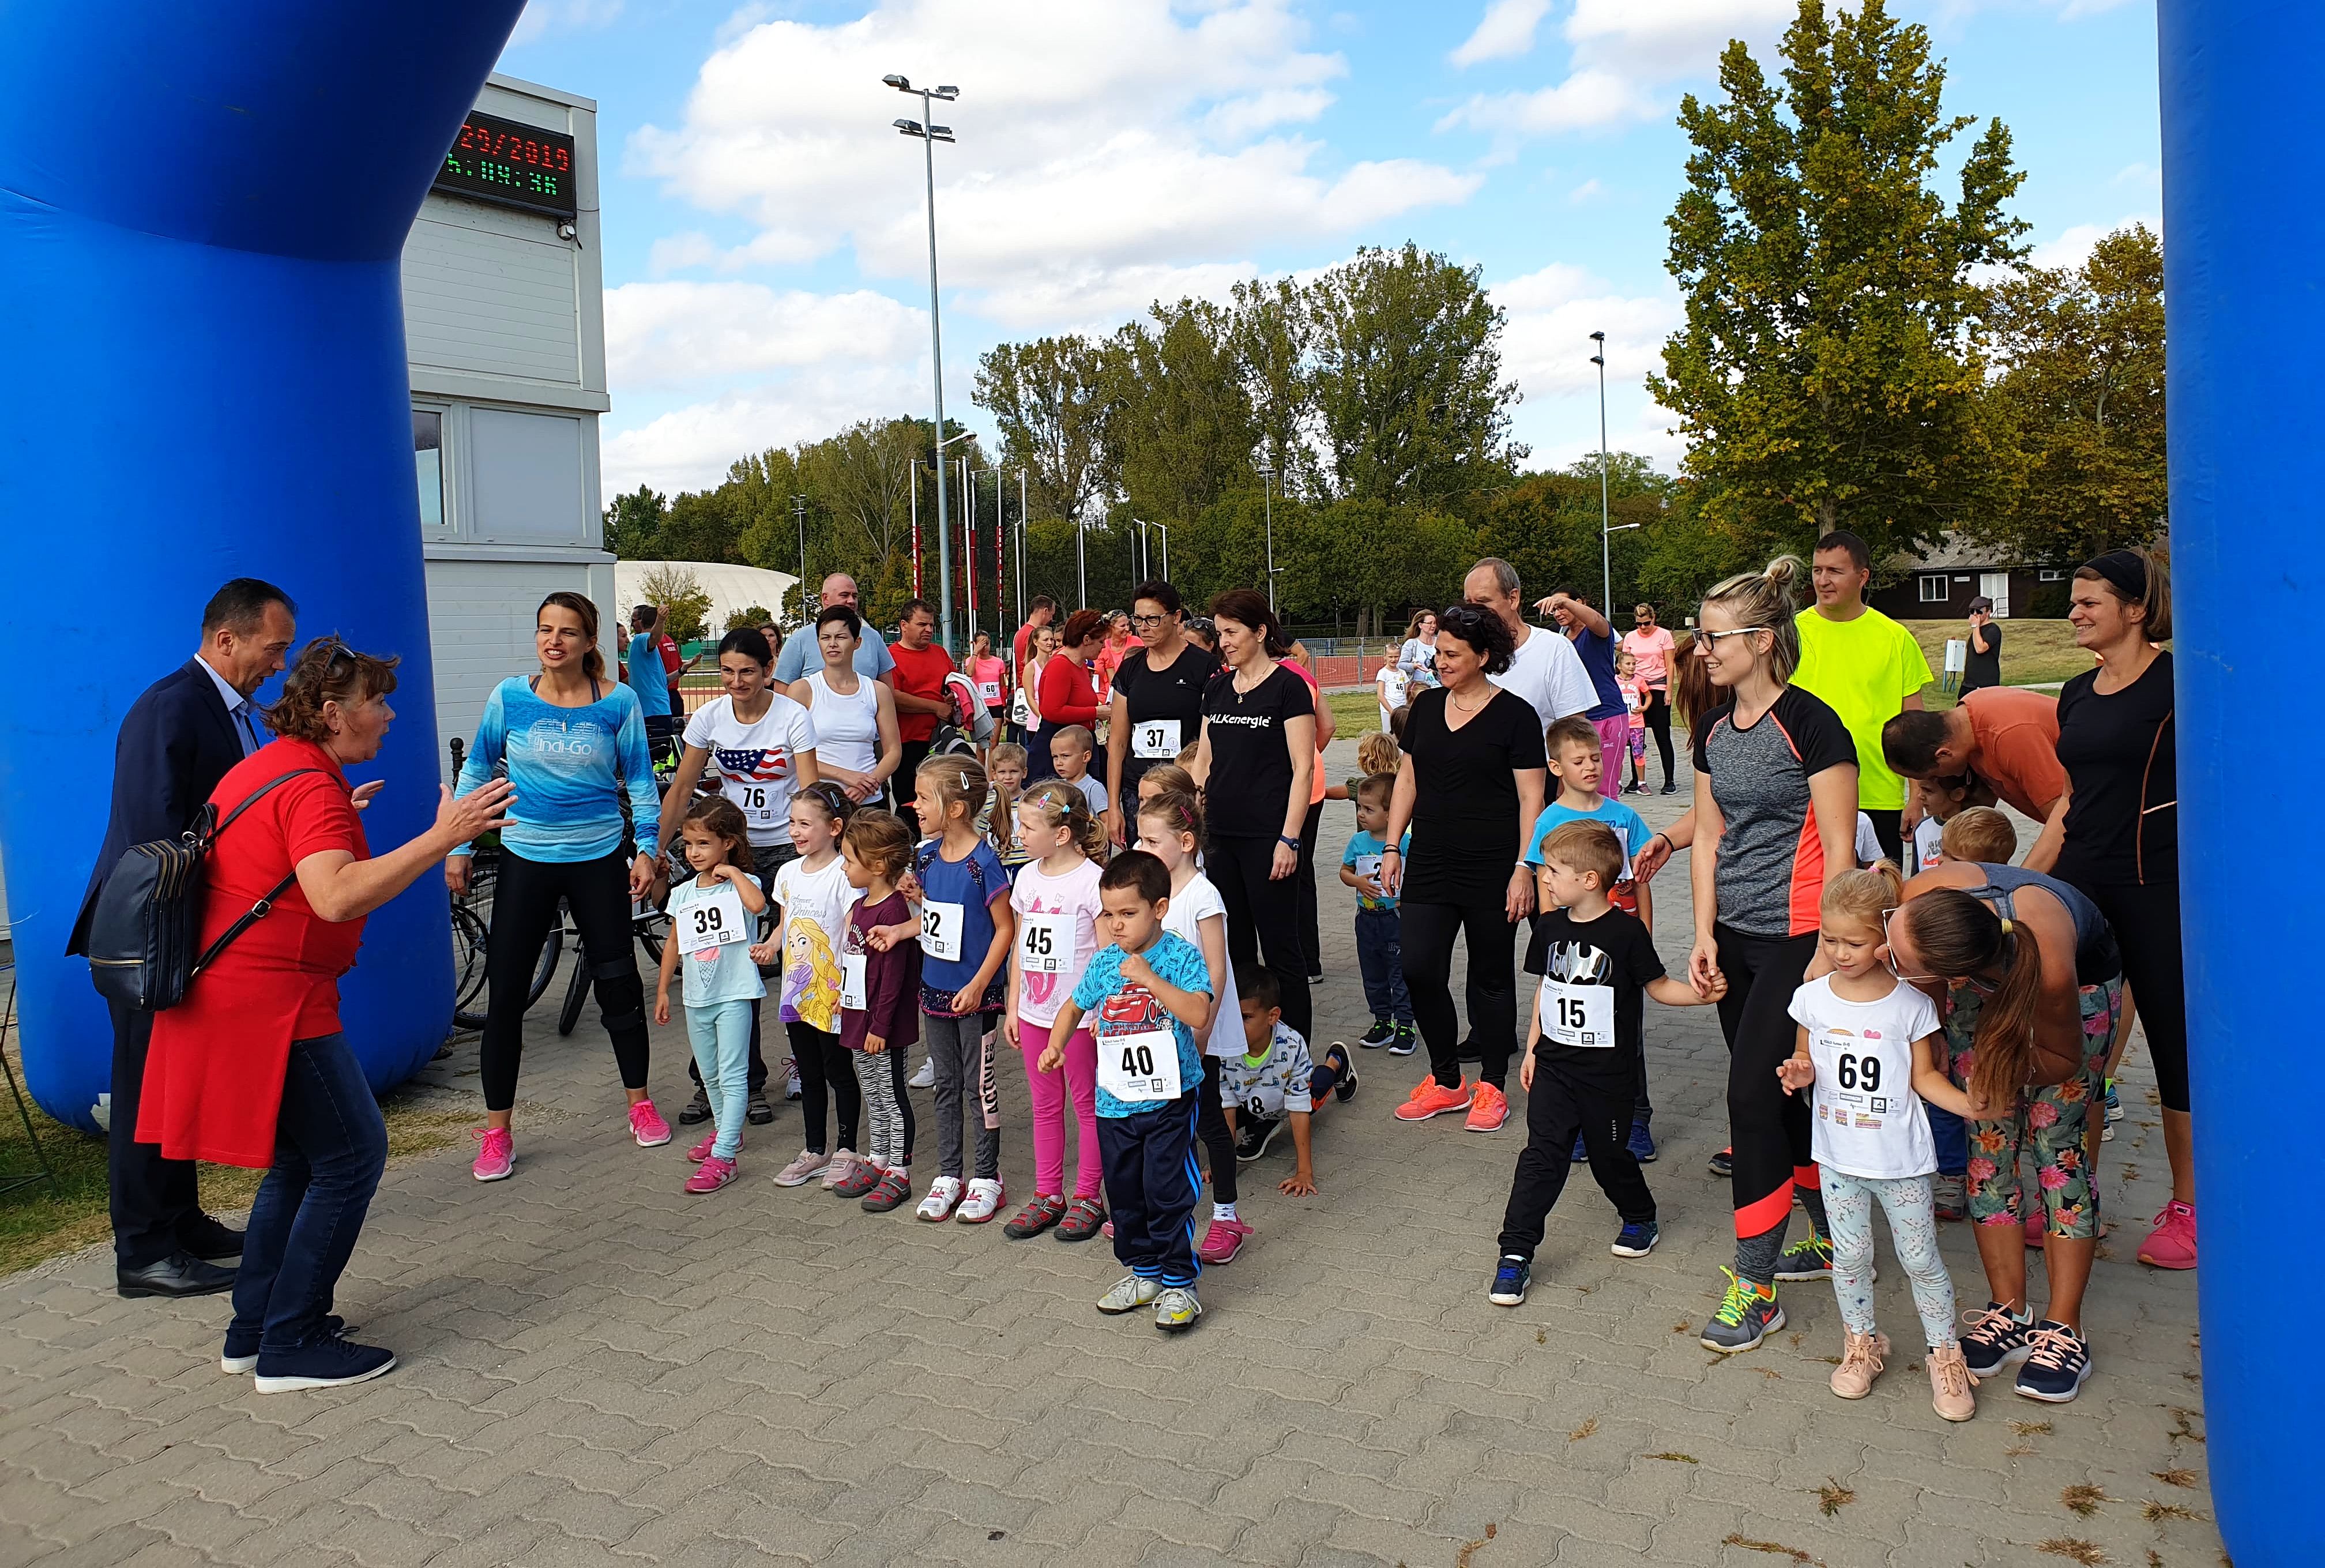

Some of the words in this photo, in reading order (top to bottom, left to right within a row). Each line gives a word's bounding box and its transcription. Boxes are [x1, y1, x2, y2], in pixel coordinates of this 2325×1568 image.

[986, 685, 995, 693] 60
[1395, 683, 1404, 691] 46
[539, 738, 592, 755] Indi-Go
[1146, 729, 1165, 748] 37
[743, 787, 766, 809] 76
[694, 907, 723, 934] 39
[789, 903, 827, 919] Princess
[923, 907, 941, 938] 52
[1026, 927, 1052, 955] 45
[1557, 998, 1586, 1029] 15
[1122, 1045, 1154, 1077] 40
[1838, 1053, 1881, 1092] 69
[983, 1051, 999, 1115] ACTIVE
